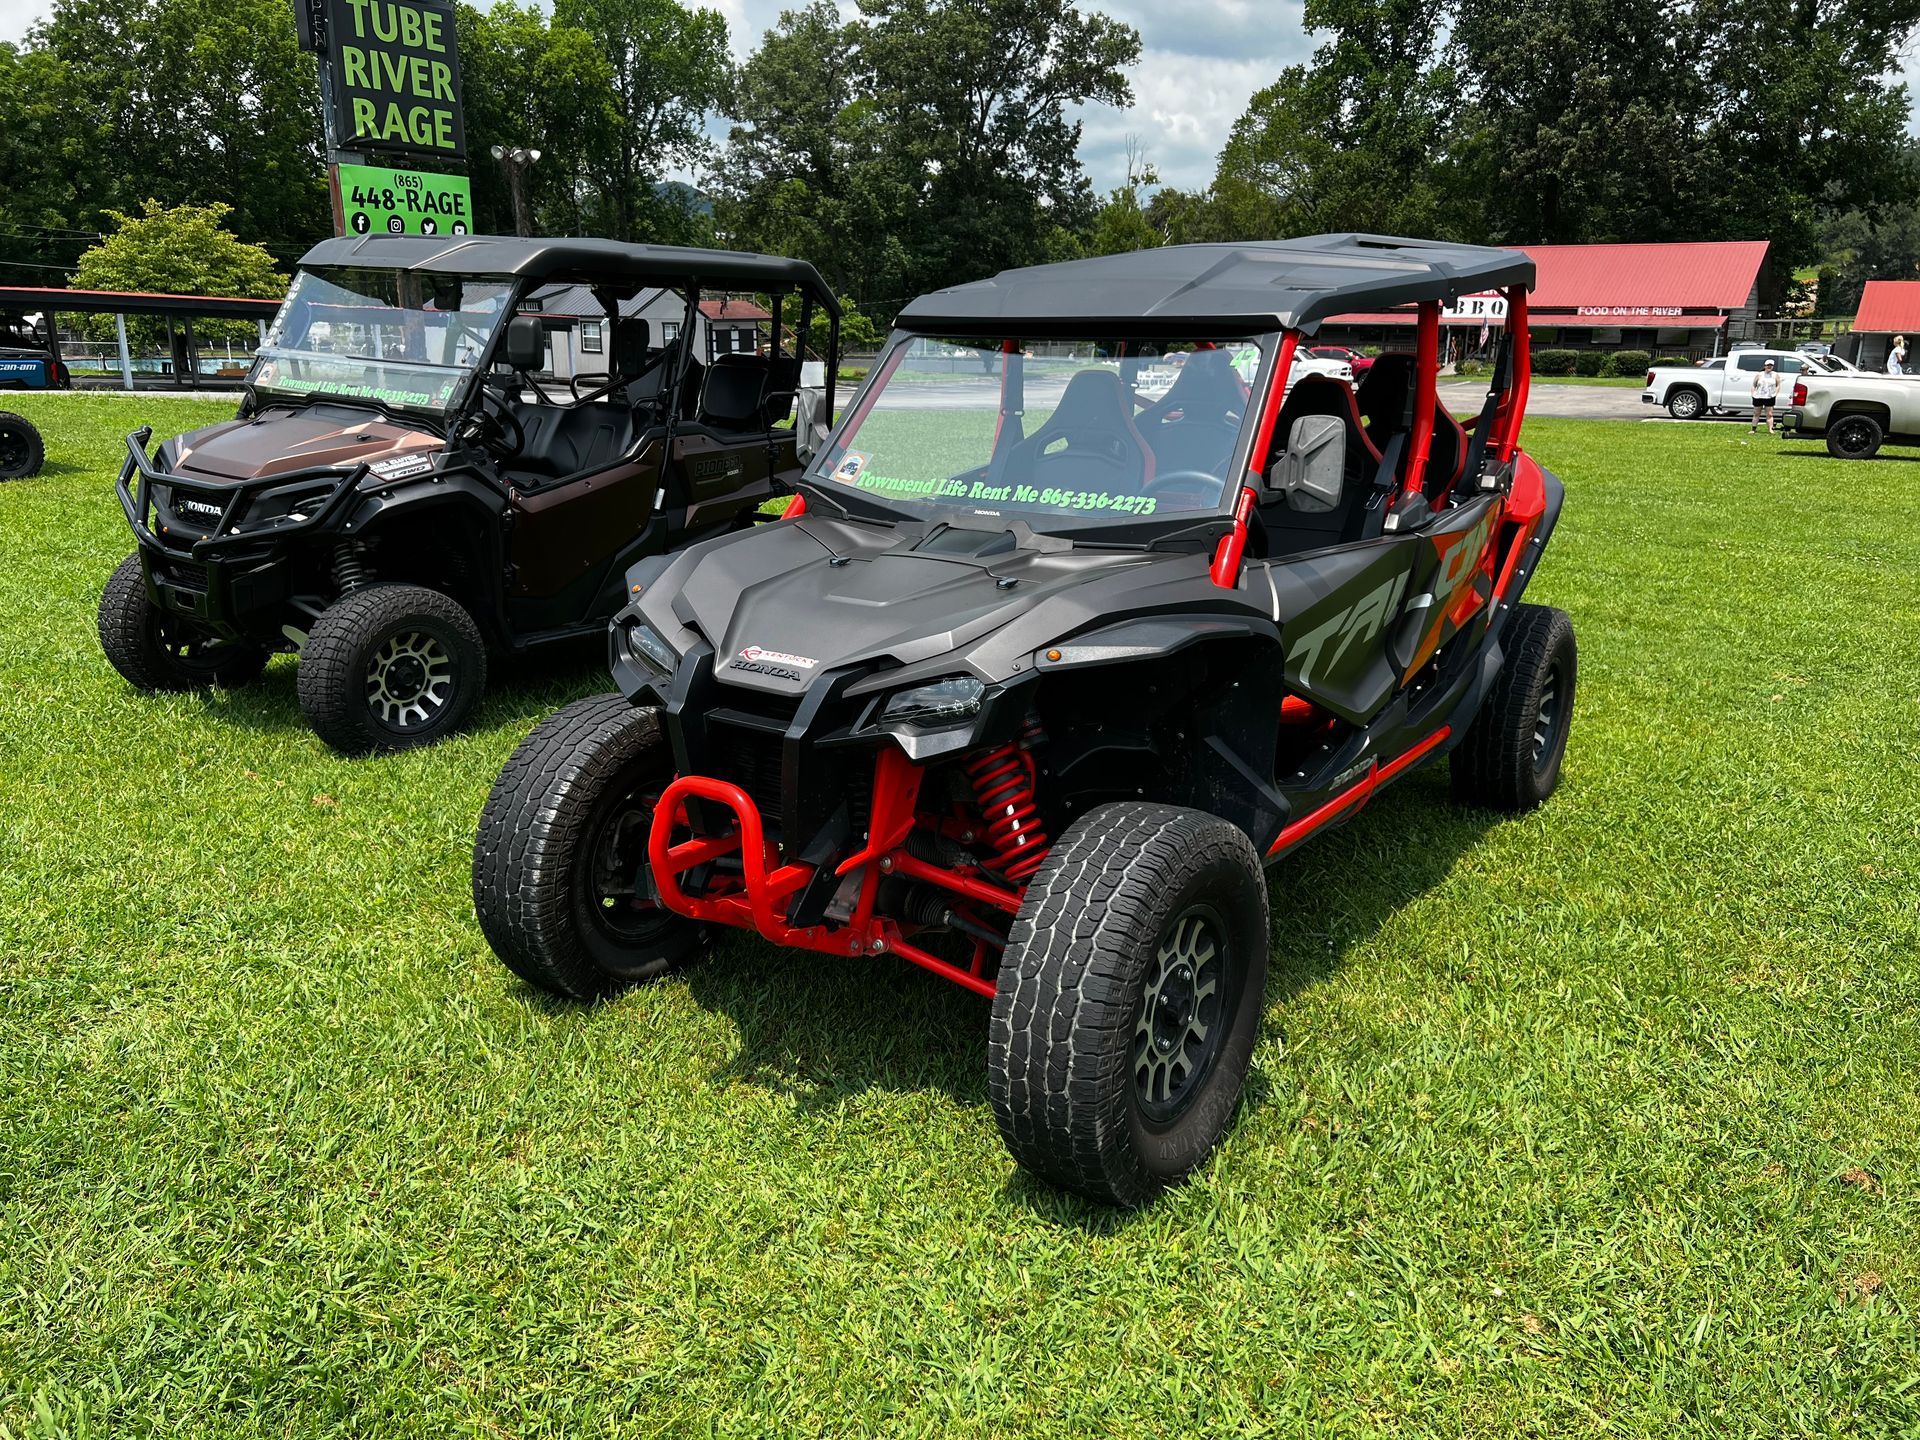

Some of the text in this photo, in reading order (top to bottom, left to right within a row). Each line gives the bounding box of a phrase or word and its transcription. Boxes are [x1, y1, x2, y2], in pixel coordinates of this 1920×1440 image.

[346, 0, 446, 53] TUBE
[342, 45, 456, 103] RIVER
[352, 97, 456, 150] RAGE
[393, 173, 424, 191] (865)
[351, 185, 466, 216] 448-RAGE
[1577, 306, 1683, 316] FOOD ON THE RIVER
[278, 375, 321, 392] Townsend
[320, 381, 338, 393] Life
[338, 383, 361, 396] Rent
[359, 384, 373, 398] Me
[856, 470, 1157, 515] Townsend Life Rent Me 865-336-2273
[974, 509, 1000, 517] HONDA
[730, 661, 801, 681] HONDA
